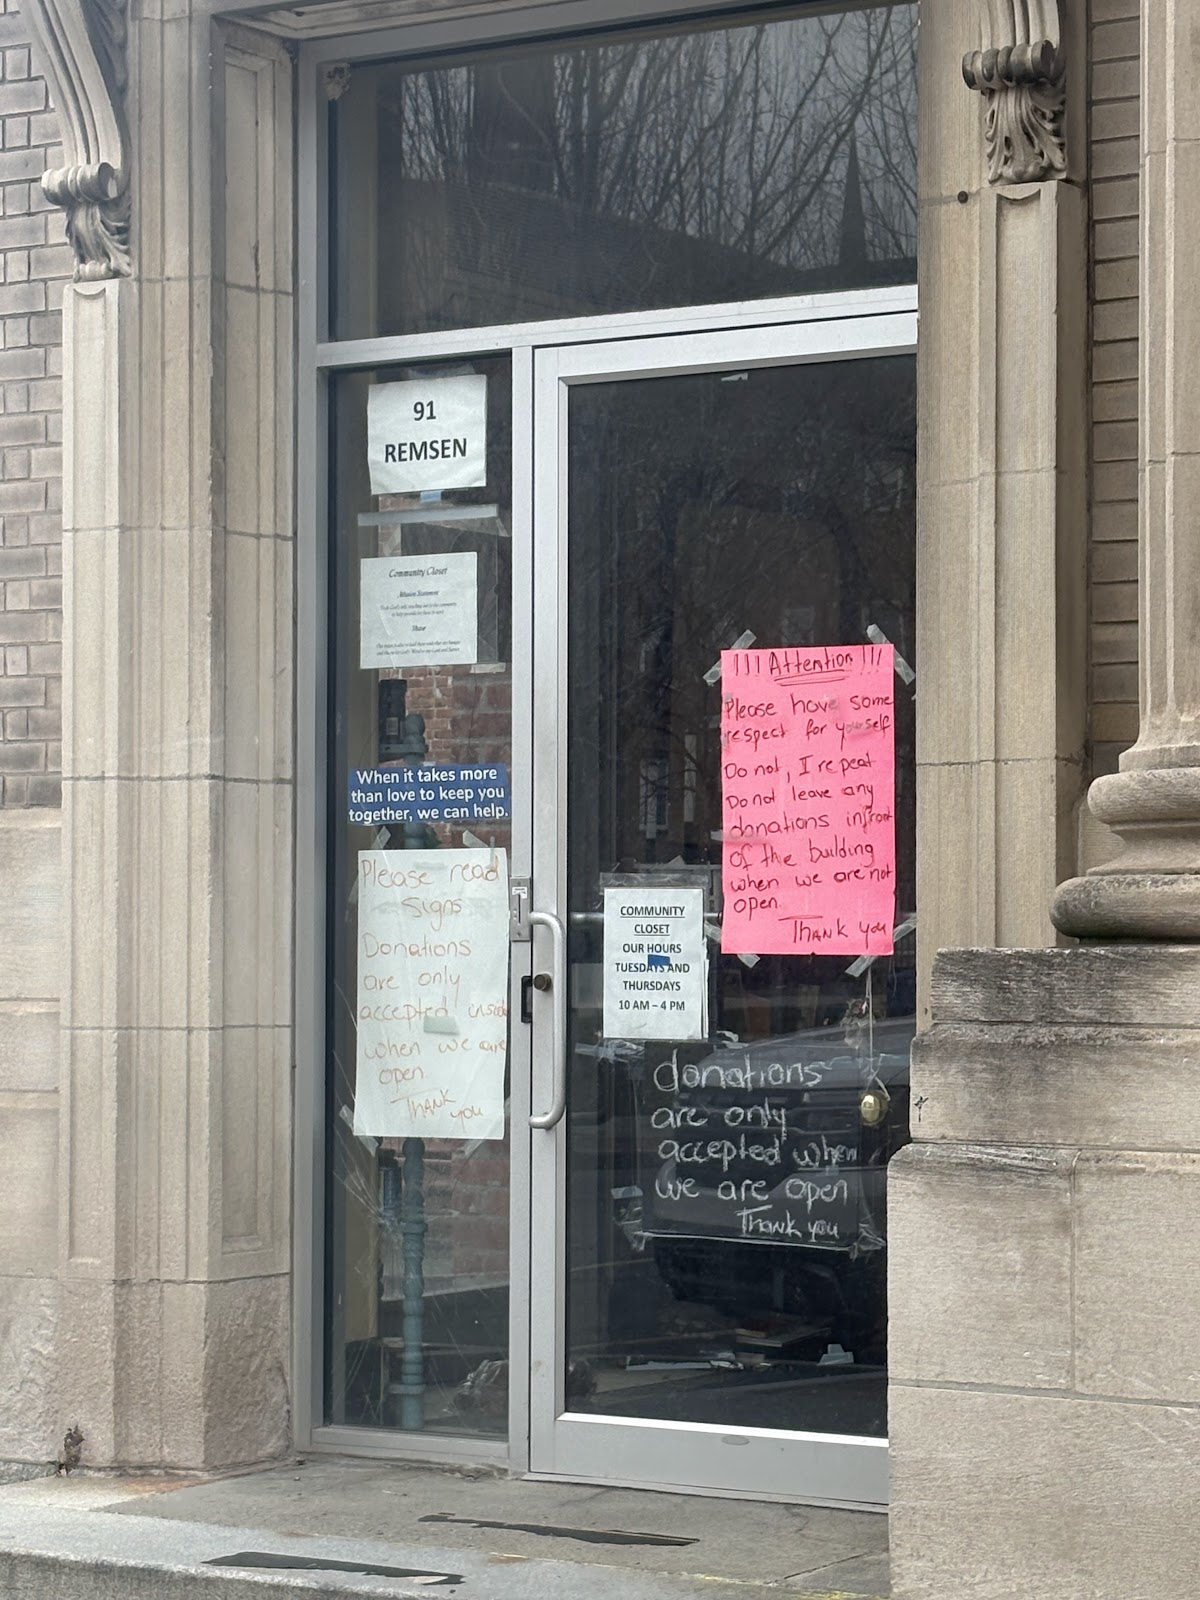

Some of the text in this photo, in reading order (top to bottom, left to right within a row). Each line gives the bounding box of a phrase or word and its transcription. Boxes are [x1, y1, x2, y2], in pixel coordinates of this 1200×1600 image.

[413, 400, 437, 421] 91
[384, 438, 467, 463] REMSEN
[389, 566, 448, 578] Community Closet
[769, 648, 853, 676] Attention
[724, 692, 894, 721] Please have some
[724, 714, 892, 752] respect for yourself
[356, 768, 497, 784] When it takes more
[725, 763, 748, 779] Do
[799, 754, 814, 777] I
[818, 751, 875, 778] repeat
[351, 786, 505, 803] than love to keep you
[726, 784, 874, 812] Do not leave any
[349, 803, 509, 824] together, we can help.
[730, 812, 830, 838] donations
[761, 843, 797, 868] the
[809, 834, 875, 868] building
[361, 855, 500, 888] Please read
[730, 864, 894, 892] when we are not
[620, 905, 686, 917] COMMUNITY
[633, 924, 670, 934] CLOSET
[859, 921, 887, 950] you
[361, 932, 471, 958] Donations
[622, 943, 682, 954] OUR HOURS
[615, 962, 690, 973] TUESDAYS AND
[363, 965, 461, 1008] are only
[623, 980, 681, 991] THURSDAYS
[360, 996, 448, 1031] accepted
[618, 999, 630, 1010] 10
[632, 1000, 650, 1010] AM
[660, 1000, 667, 1011] 4
[669, 1000, 685, 1011] PM
[364, 1037, 506, 1059] when we are
[379, 1066, 424, 1093] open
[653, 1049, 826, 1095] donations
[450, 1105, 484, 1133] you
[651, 1097, 787, 1145] are only
[658, 1133, 858, 1172] accepted when
[655, 1177, 848, 1214] we are open
[808, 1219, 839, 1242] you
